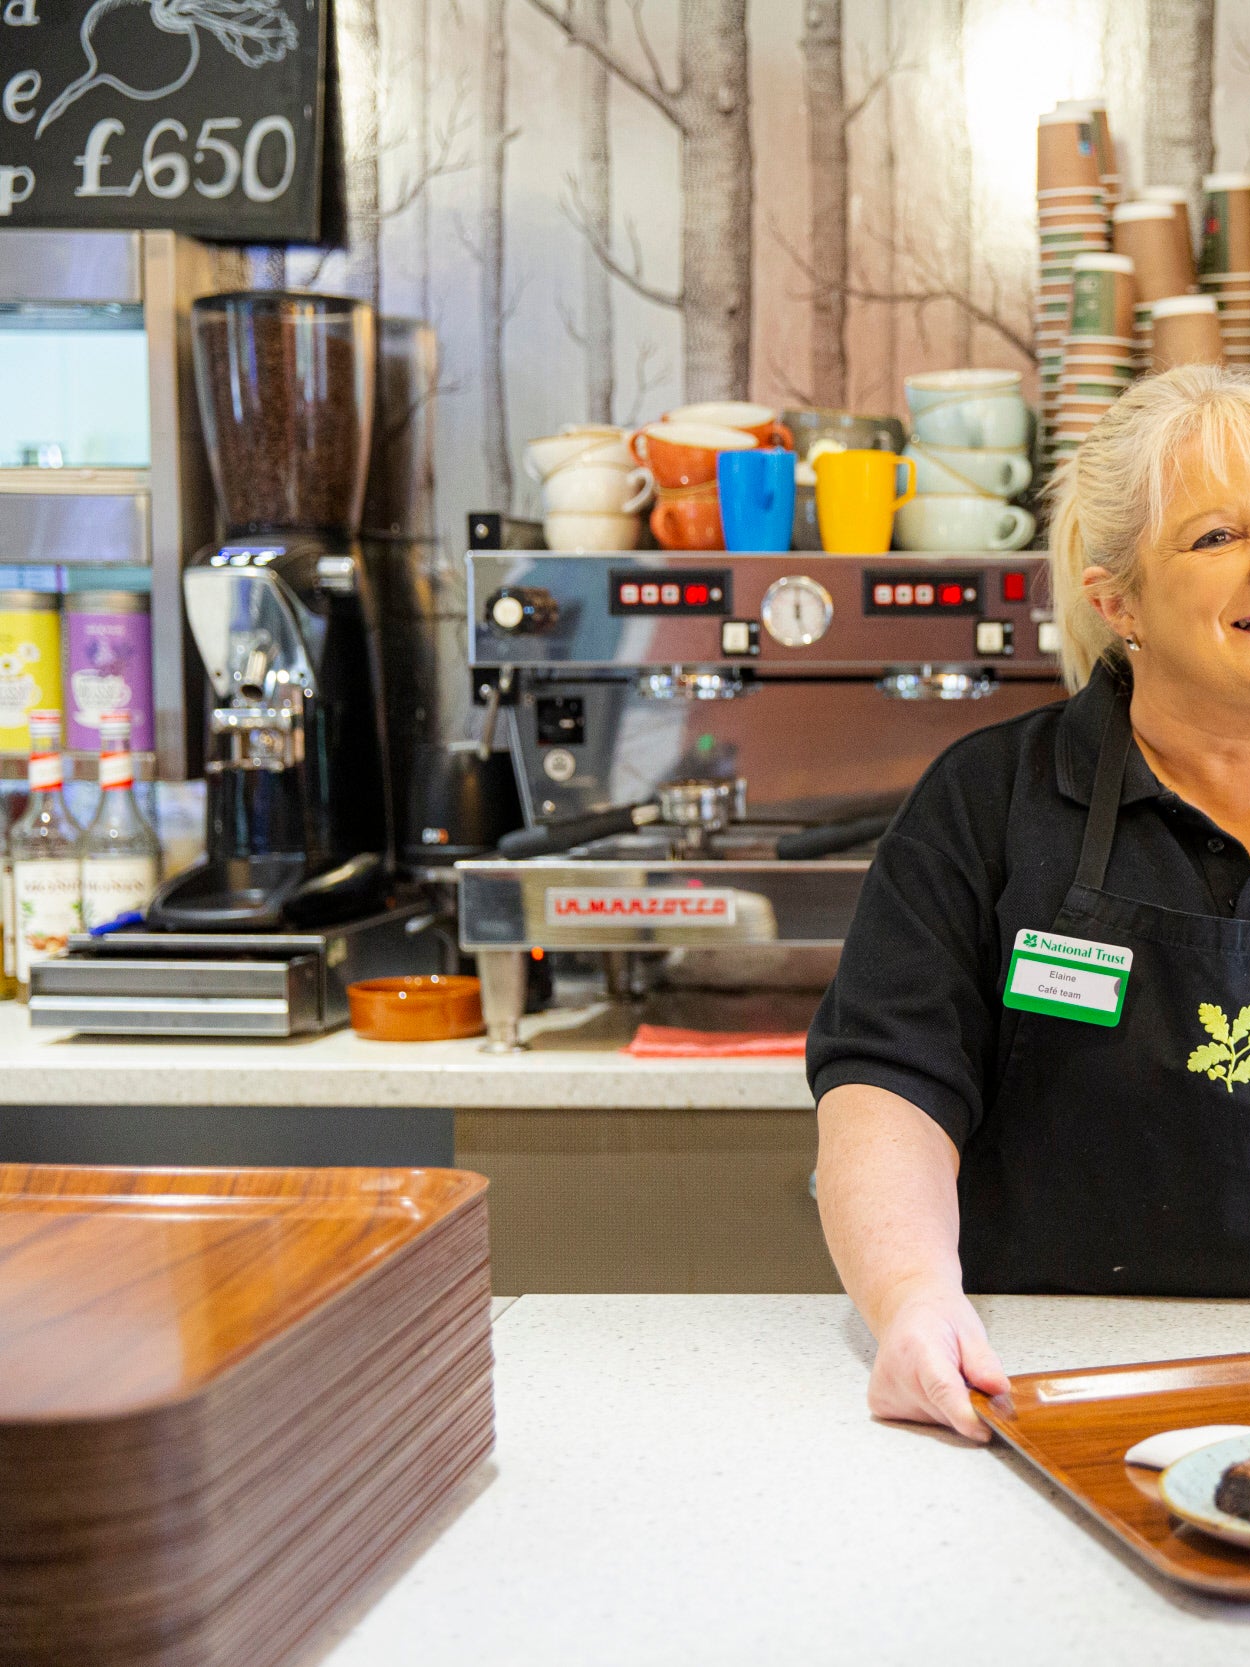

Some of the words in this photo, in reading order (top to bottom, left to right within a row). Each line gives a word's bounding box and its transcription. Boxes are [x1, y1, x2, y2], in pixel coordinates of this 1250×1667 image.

[1040, 938, 1092, 959] National
[1096, 948, 1125, 965] Trust
[1049, 970, 1077, 982] Elaine
[1038, 985, 1058, 995] Café
[1060, 989, 1081, 999] team
